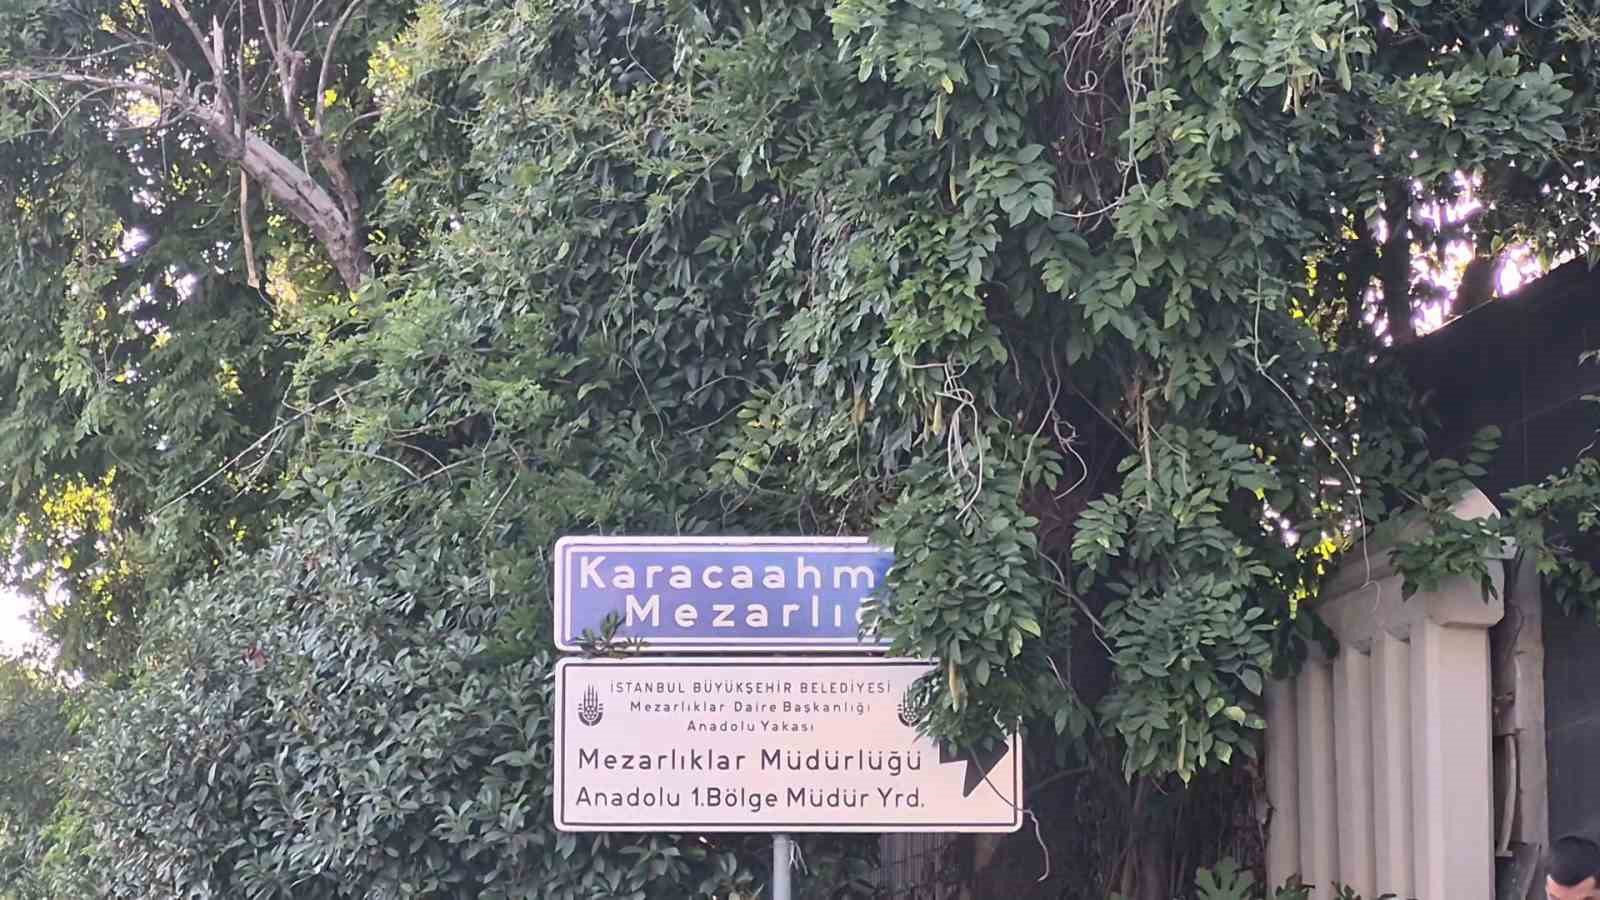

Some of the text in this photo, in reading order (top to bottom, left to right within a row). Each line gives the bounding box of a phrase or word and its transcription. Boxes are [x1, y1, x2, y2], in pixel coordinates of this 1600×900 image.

[579, 556, 892, 590] Karacaahm
[610, 679, 891, 696] İSTANBUL BÜYÜKŞEHİR BELEDİYESİ
[630, 701, 871, 716] Mezarlıklar Daire Başkanlığı
[687, 720, 814, 732] Anadolu Yakası
[578, 748, 922, 777] Mezarlıklar Müdürlüğü
[575, 786, 926, 813] Anadolu 1.Bölge Müdür Yrd.
